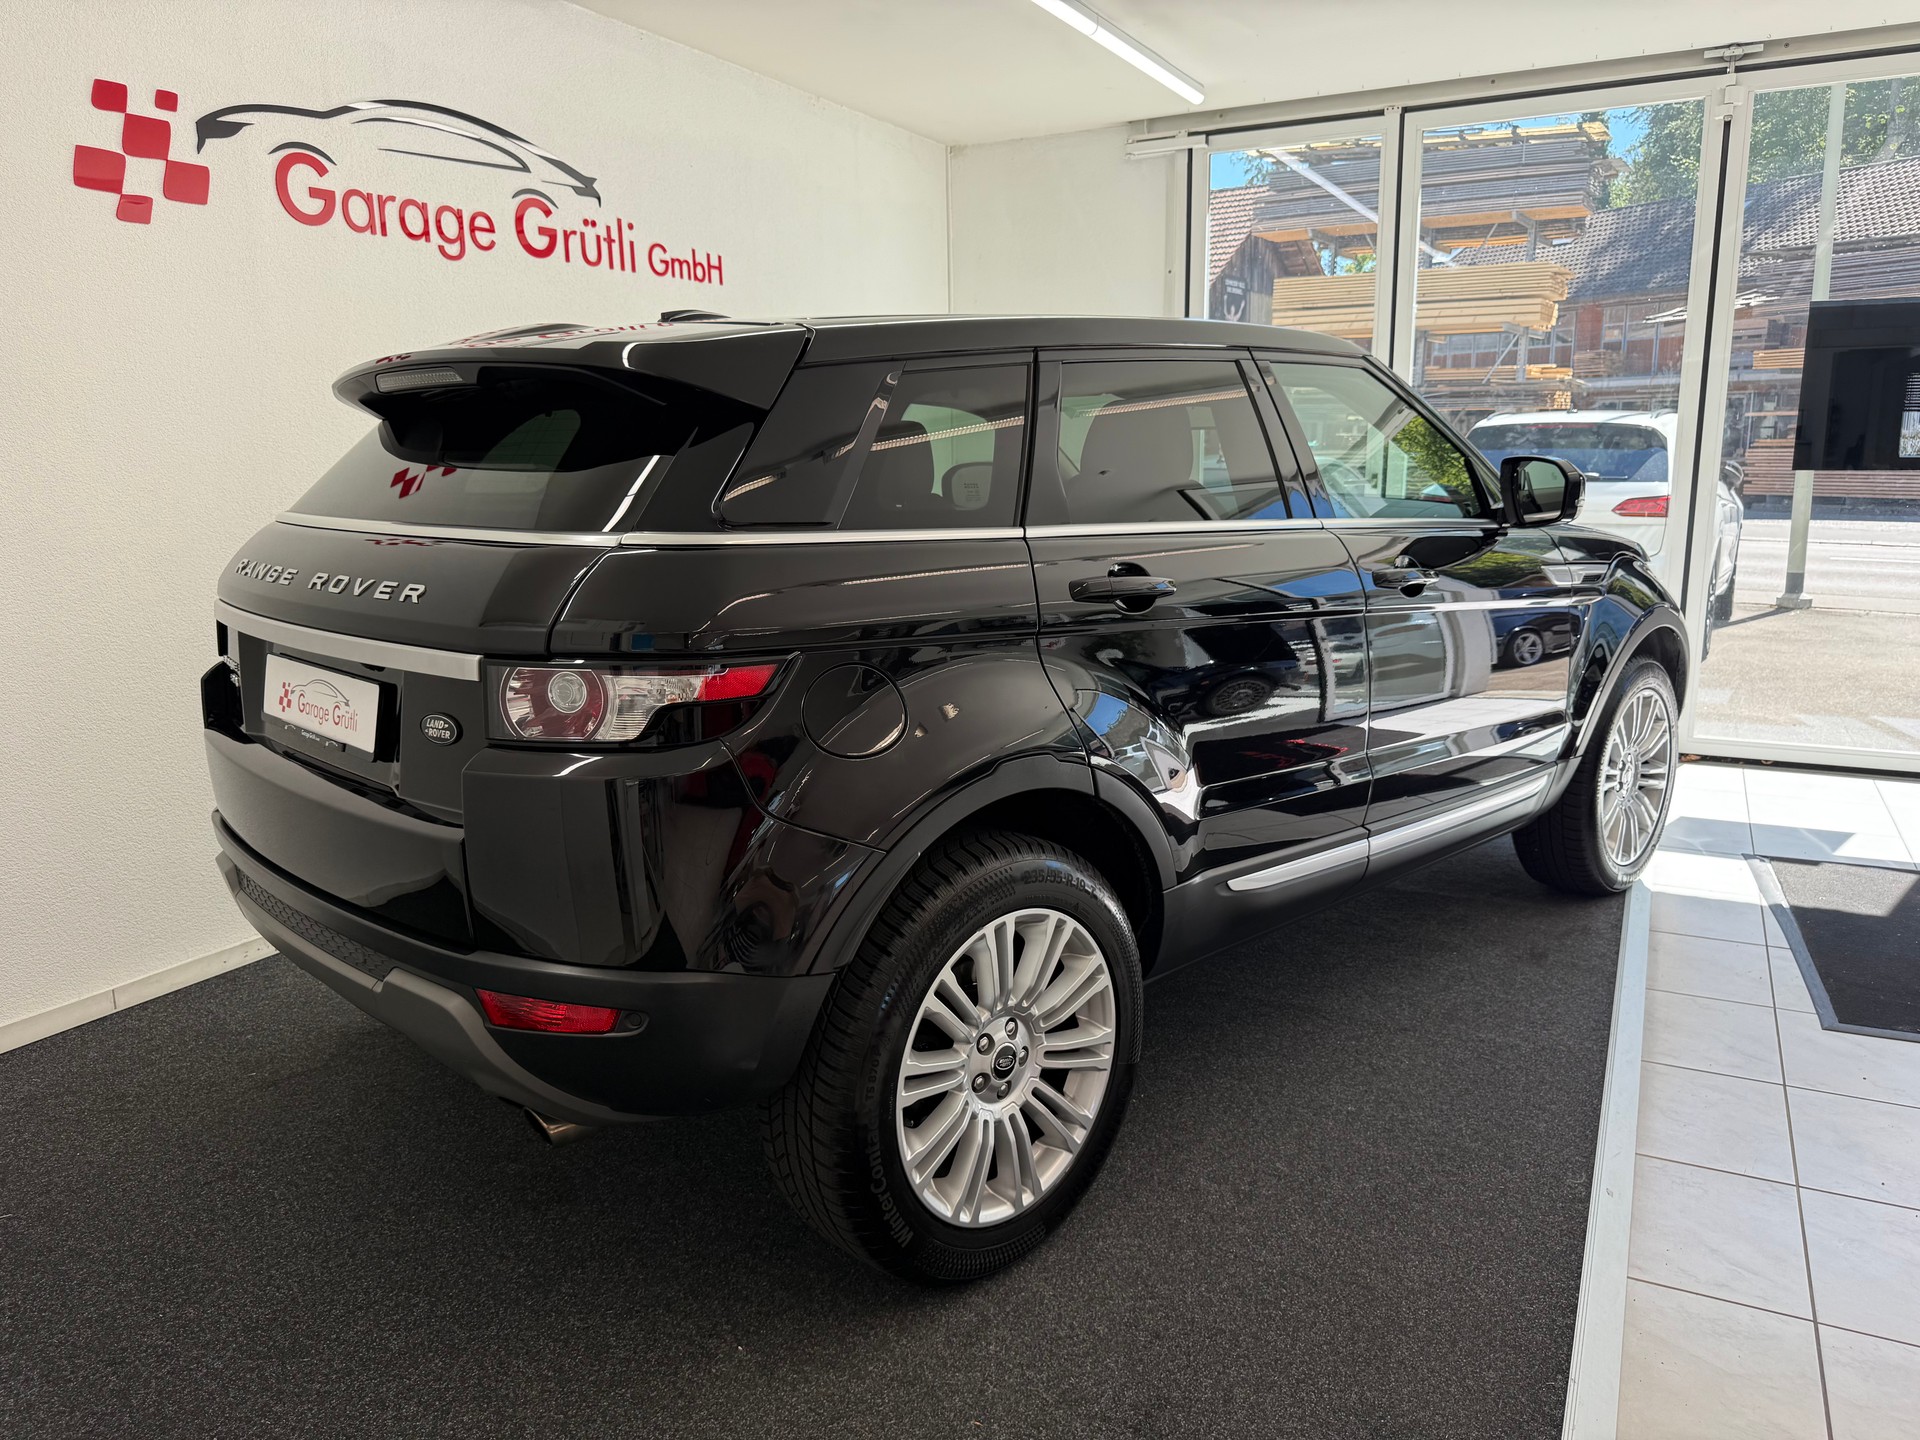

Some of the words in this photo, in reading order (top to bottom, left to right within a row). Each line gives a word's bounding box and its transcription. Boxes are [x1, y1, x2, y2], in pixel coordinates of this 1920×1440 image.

[275, 152, 497, 261] Garage
[514, 198, 637, 274] Grütli
[647, 242, 724, 286] GmbH
[234, 558, 298, 586] RANGE
[307, 572, 426, 604] ROVER
[297, 692, 330, 725] Garage
[332, 701, 358, 732] Grütli
[425, 718, 444, 730] LAND
[427, 727, 451, 739] ROVER
